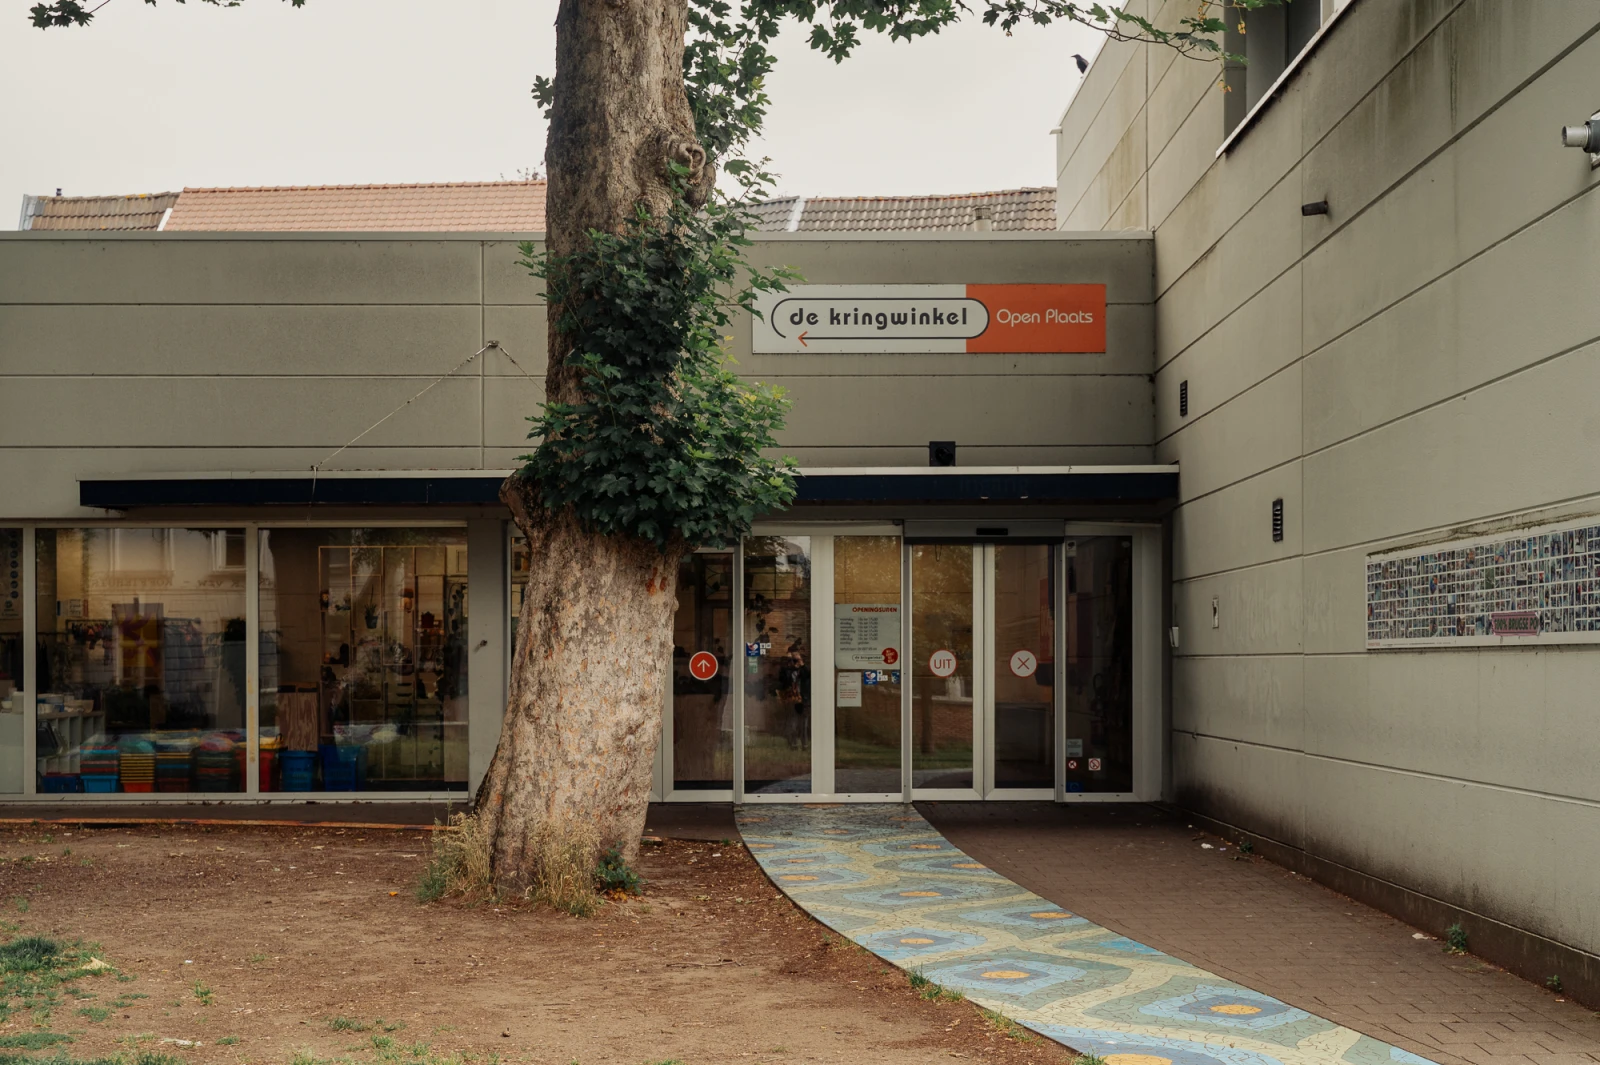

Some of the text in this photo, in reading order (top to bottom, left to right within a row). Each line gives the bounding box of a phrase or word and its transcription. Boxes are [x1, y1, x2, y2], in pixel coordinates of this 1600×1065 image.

[789, 307, 1093, 330] de kringwinkel Open Plaats
[934, 659, 952, 669] UIT
